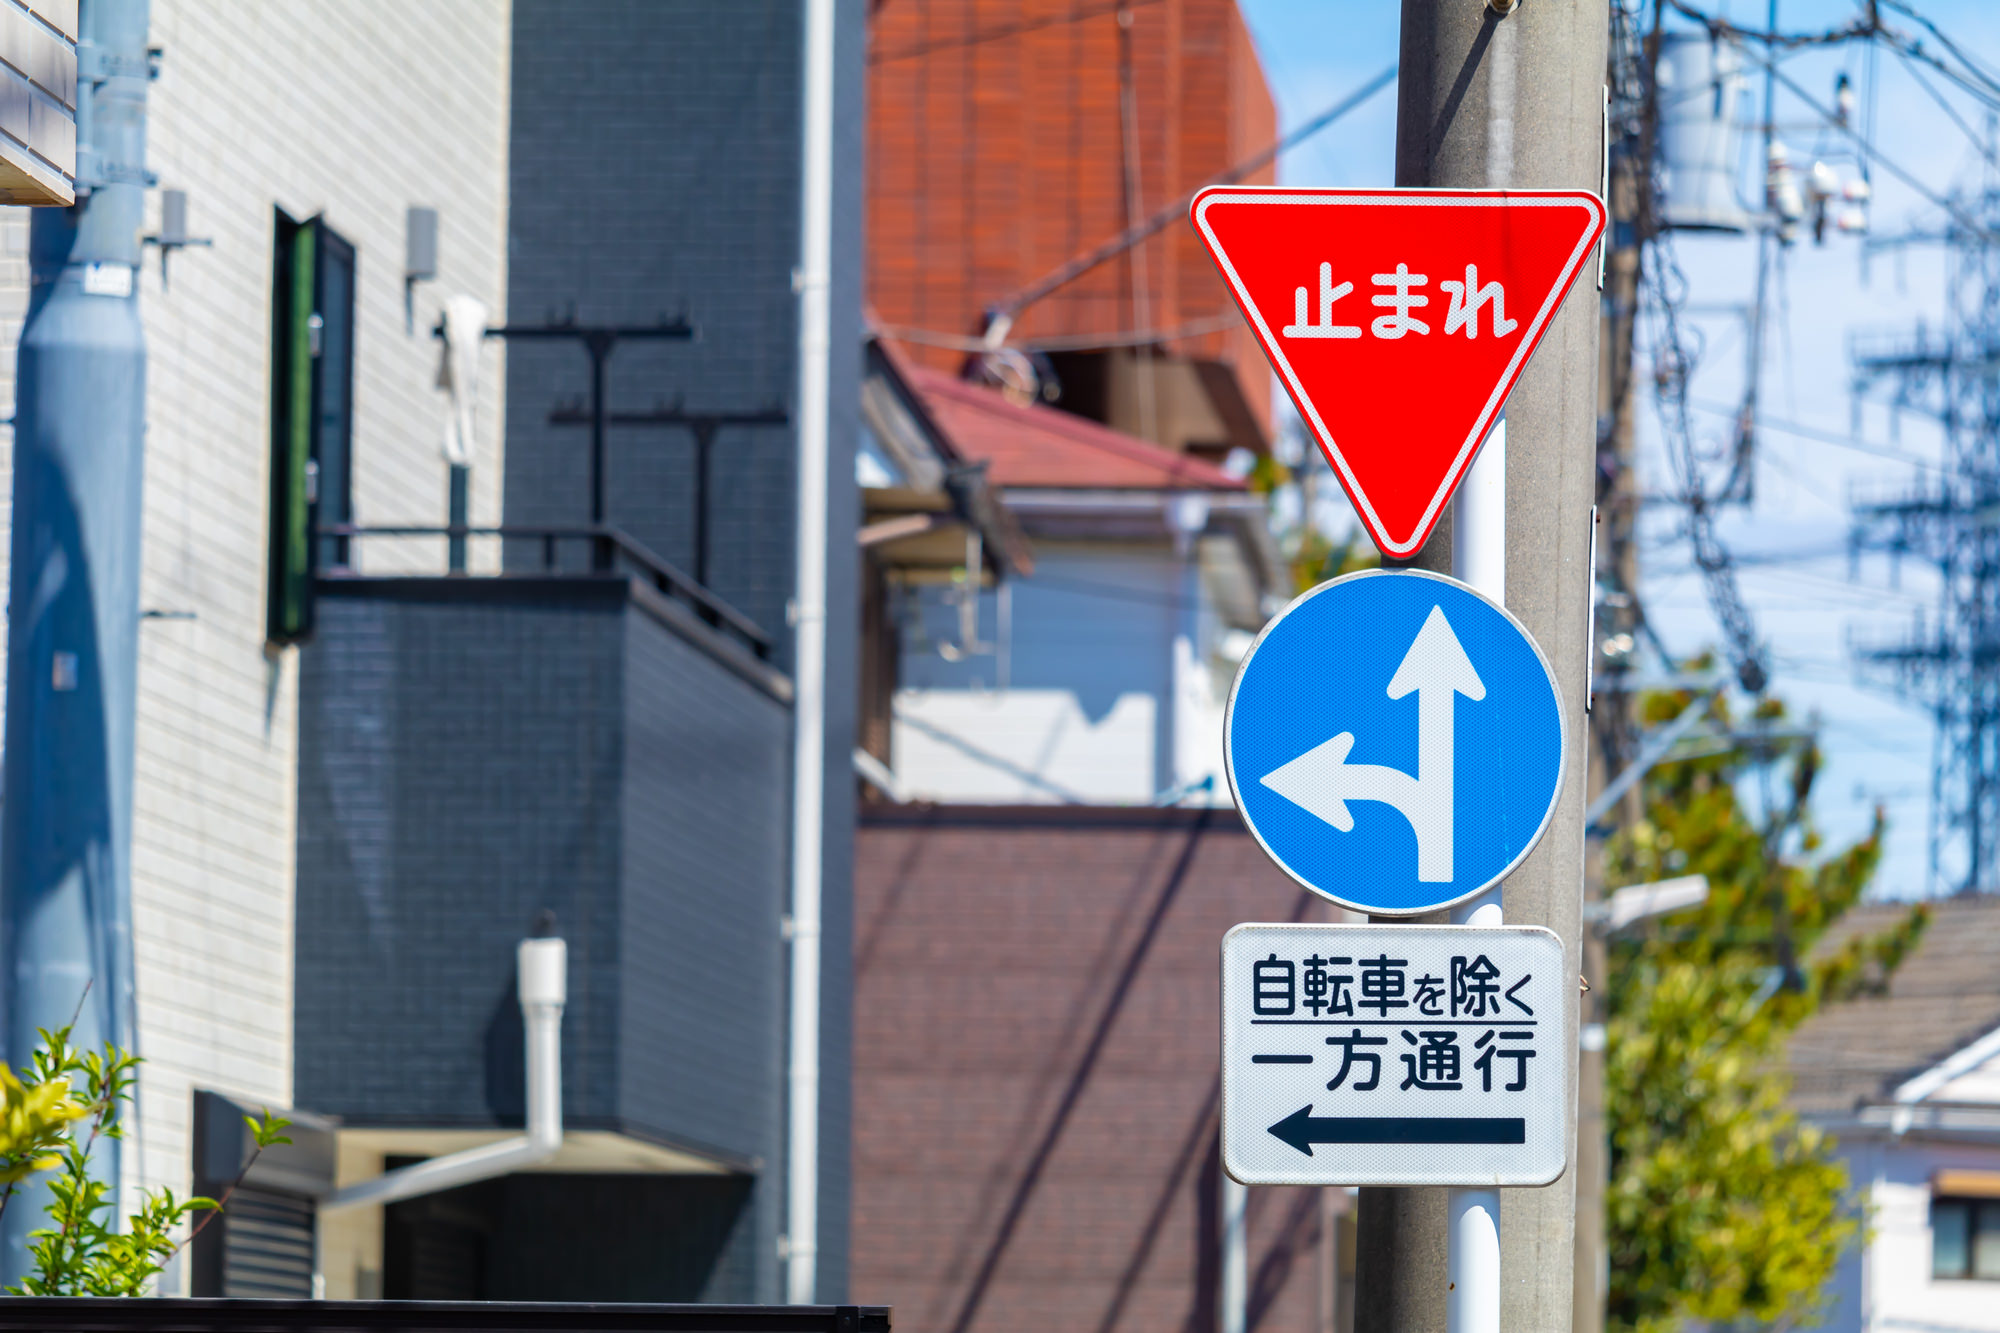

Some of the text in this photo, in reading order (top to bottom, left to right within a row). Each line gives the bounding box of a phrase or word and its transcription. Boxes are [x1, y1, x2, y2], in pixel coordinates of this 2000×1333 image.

[1283, 262, 1518, 339] 止まれ
[1253, 954, 1534, 1017] 自転車を除く
[1252, 1029, 1536, 1092] 一方通行
